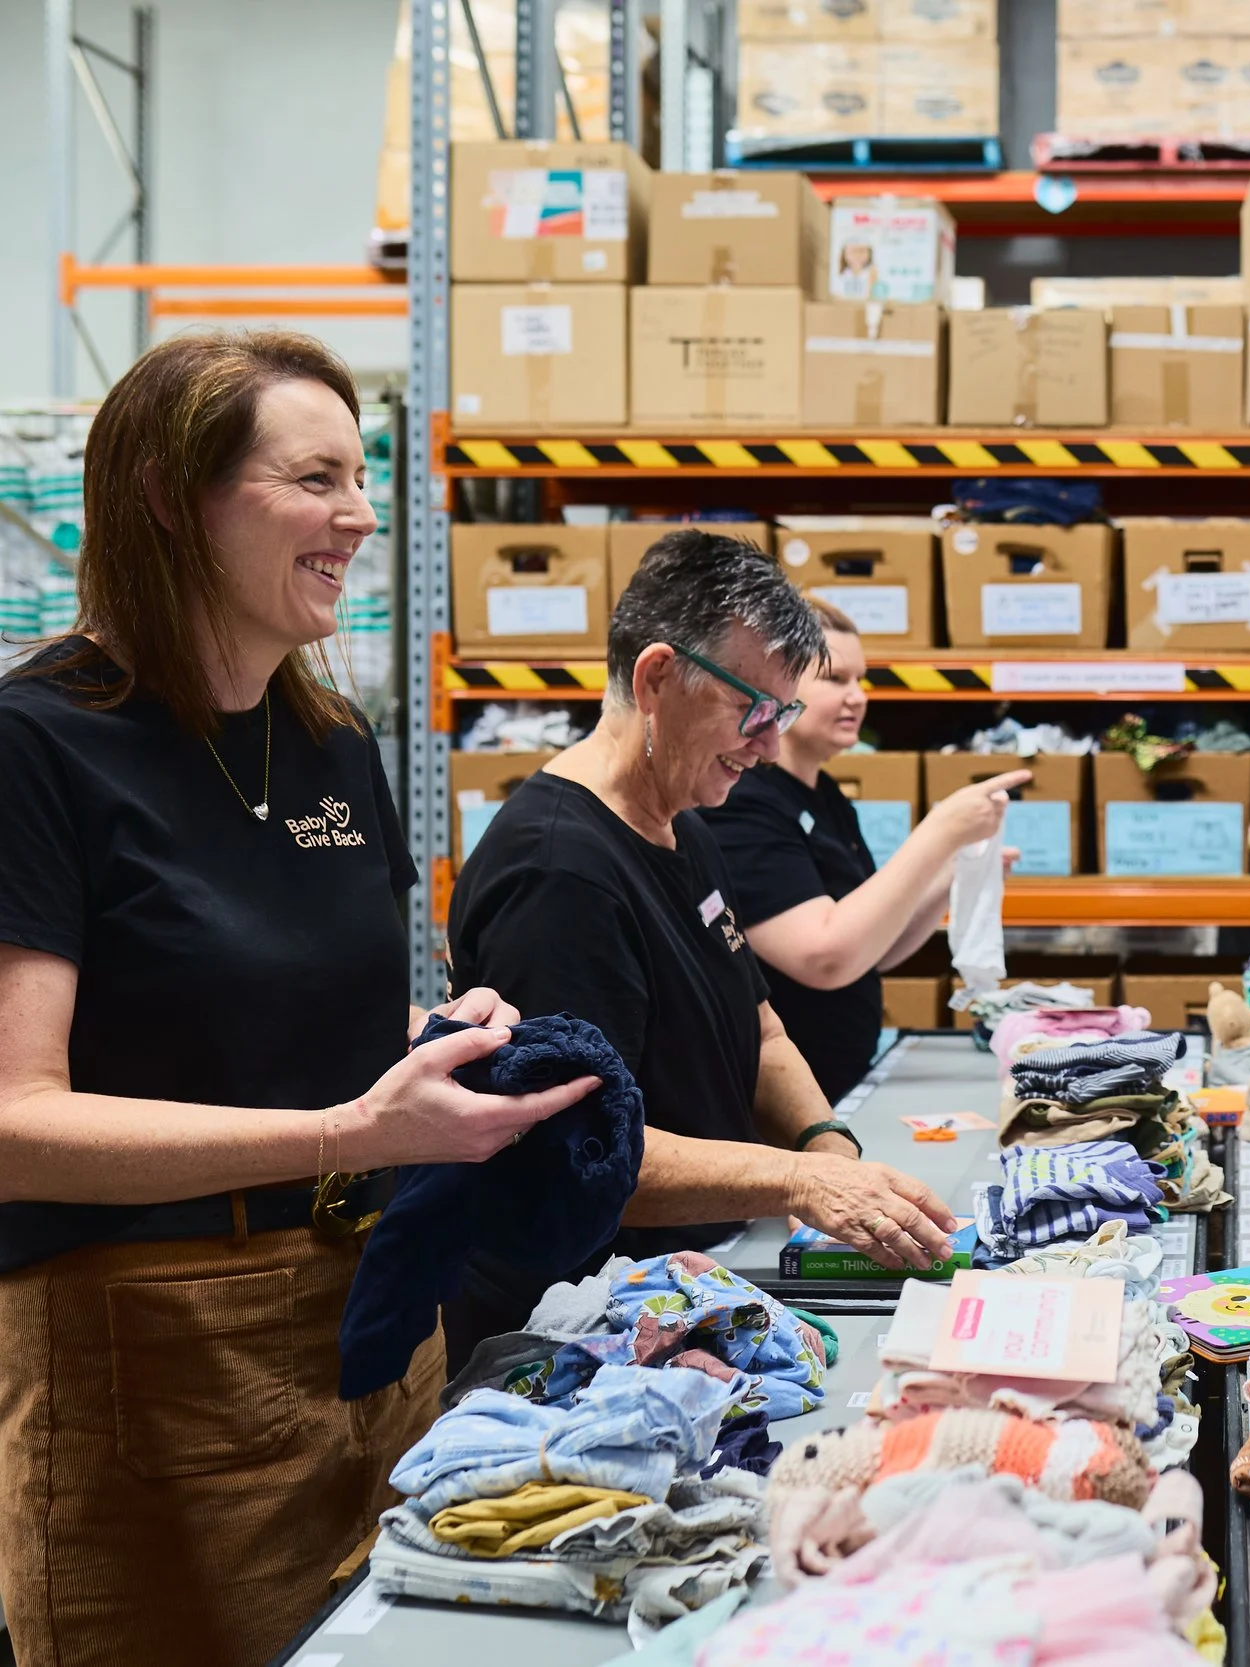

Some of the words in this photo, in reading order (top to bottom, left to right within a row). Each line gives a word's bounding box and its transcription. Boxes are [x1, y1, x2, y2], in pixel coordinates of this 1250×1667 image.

[285, 815, 327, 833] Baby
[295, 832, 331, 848] Give
[331, 830, 366, 846] Back
[784, 1256, 792, 1275] mini
[791, 1261, 798, 1275] me
